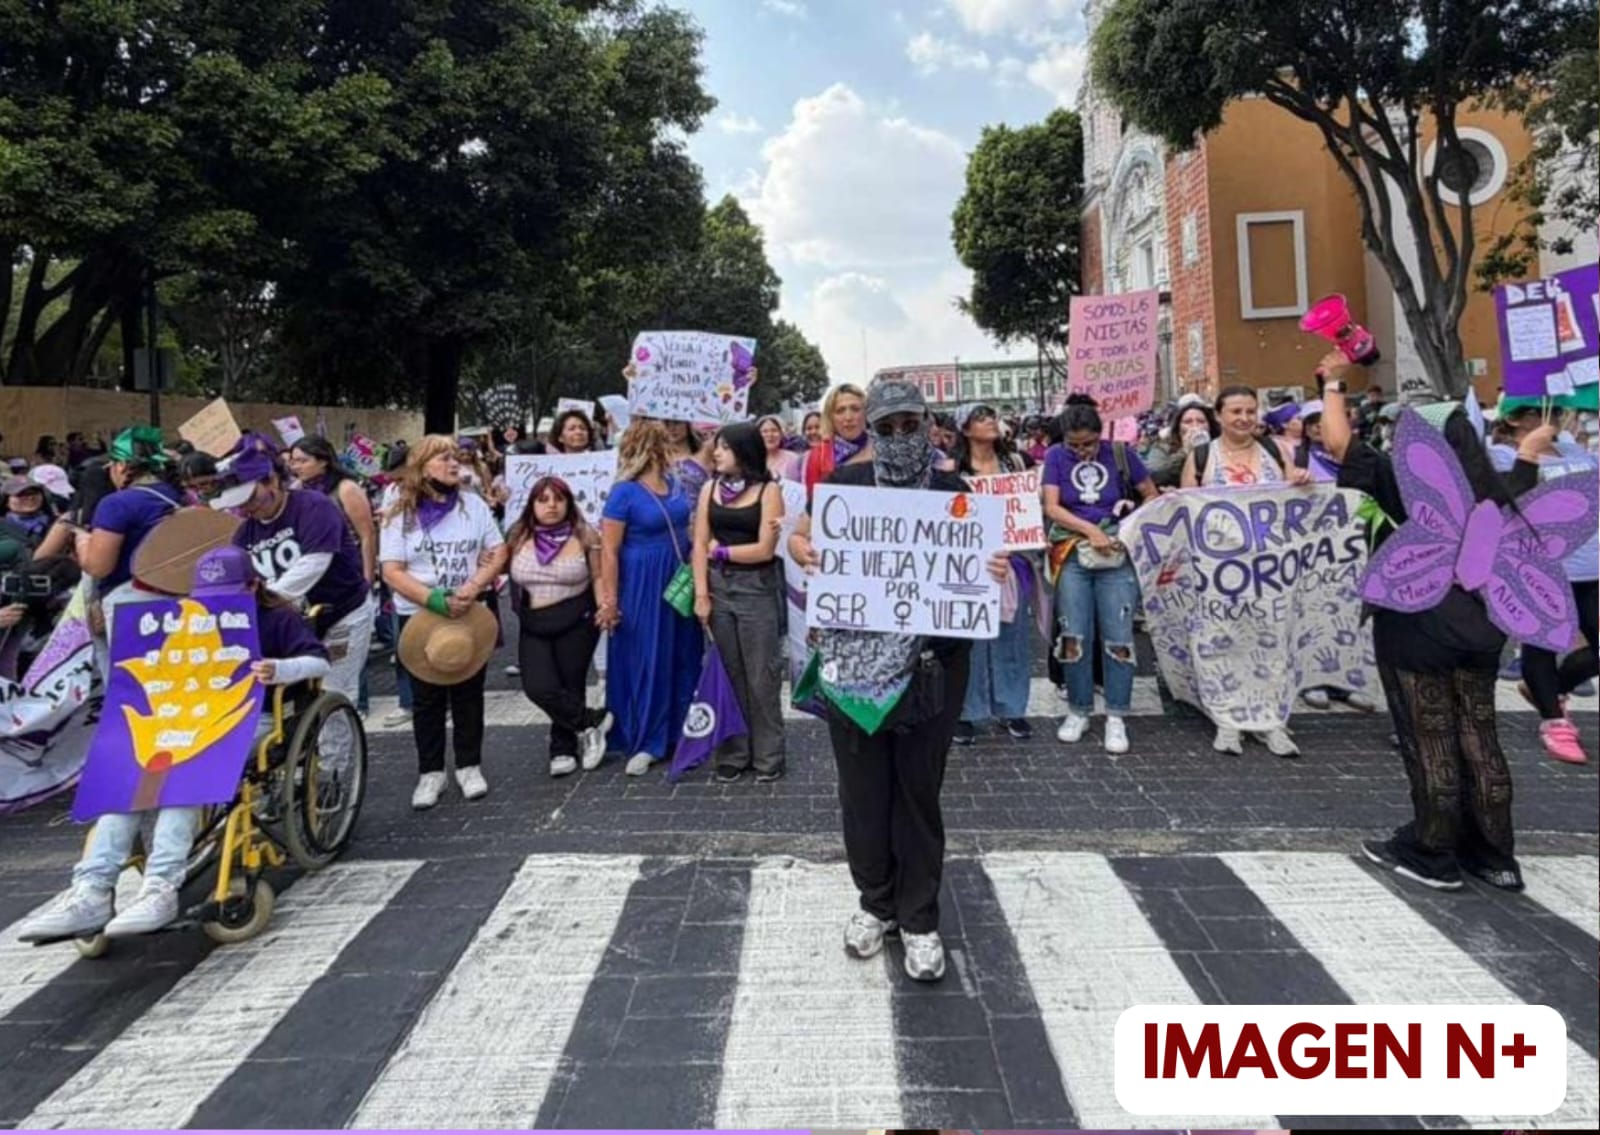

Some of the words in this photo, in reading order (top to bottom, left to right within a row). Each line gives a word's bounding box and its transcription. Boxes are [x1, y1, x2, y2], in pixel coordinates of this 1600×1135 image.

[1083, 303, 1127, 320] SOMOS
[1084, 316, 1148, 341] NIETAS
[1076, 347, 1094, 359] DE
[1101, 390, 1139, 414] EMAR
[821, 494, 908, 544] QUIERO
[913, 517, 984, 549] MORIR
[1418, 505, 1444, 533] Nos
[414, 539, 478, 556] JUSTICIA
[437, 556, 468, 572] ARA
[820, 549, 852, 576] DE
[861, 550, 918, 580] VIEJA
[923, 551, 938, 582] Y
[946, 553, 980, 584] NO
[885, 581, 921, 600] POR
[1493, 585, 1523, 620] Alas
[816, 592, 867, 624] SER
[924, 599, 998, 632] "VIEJA"
